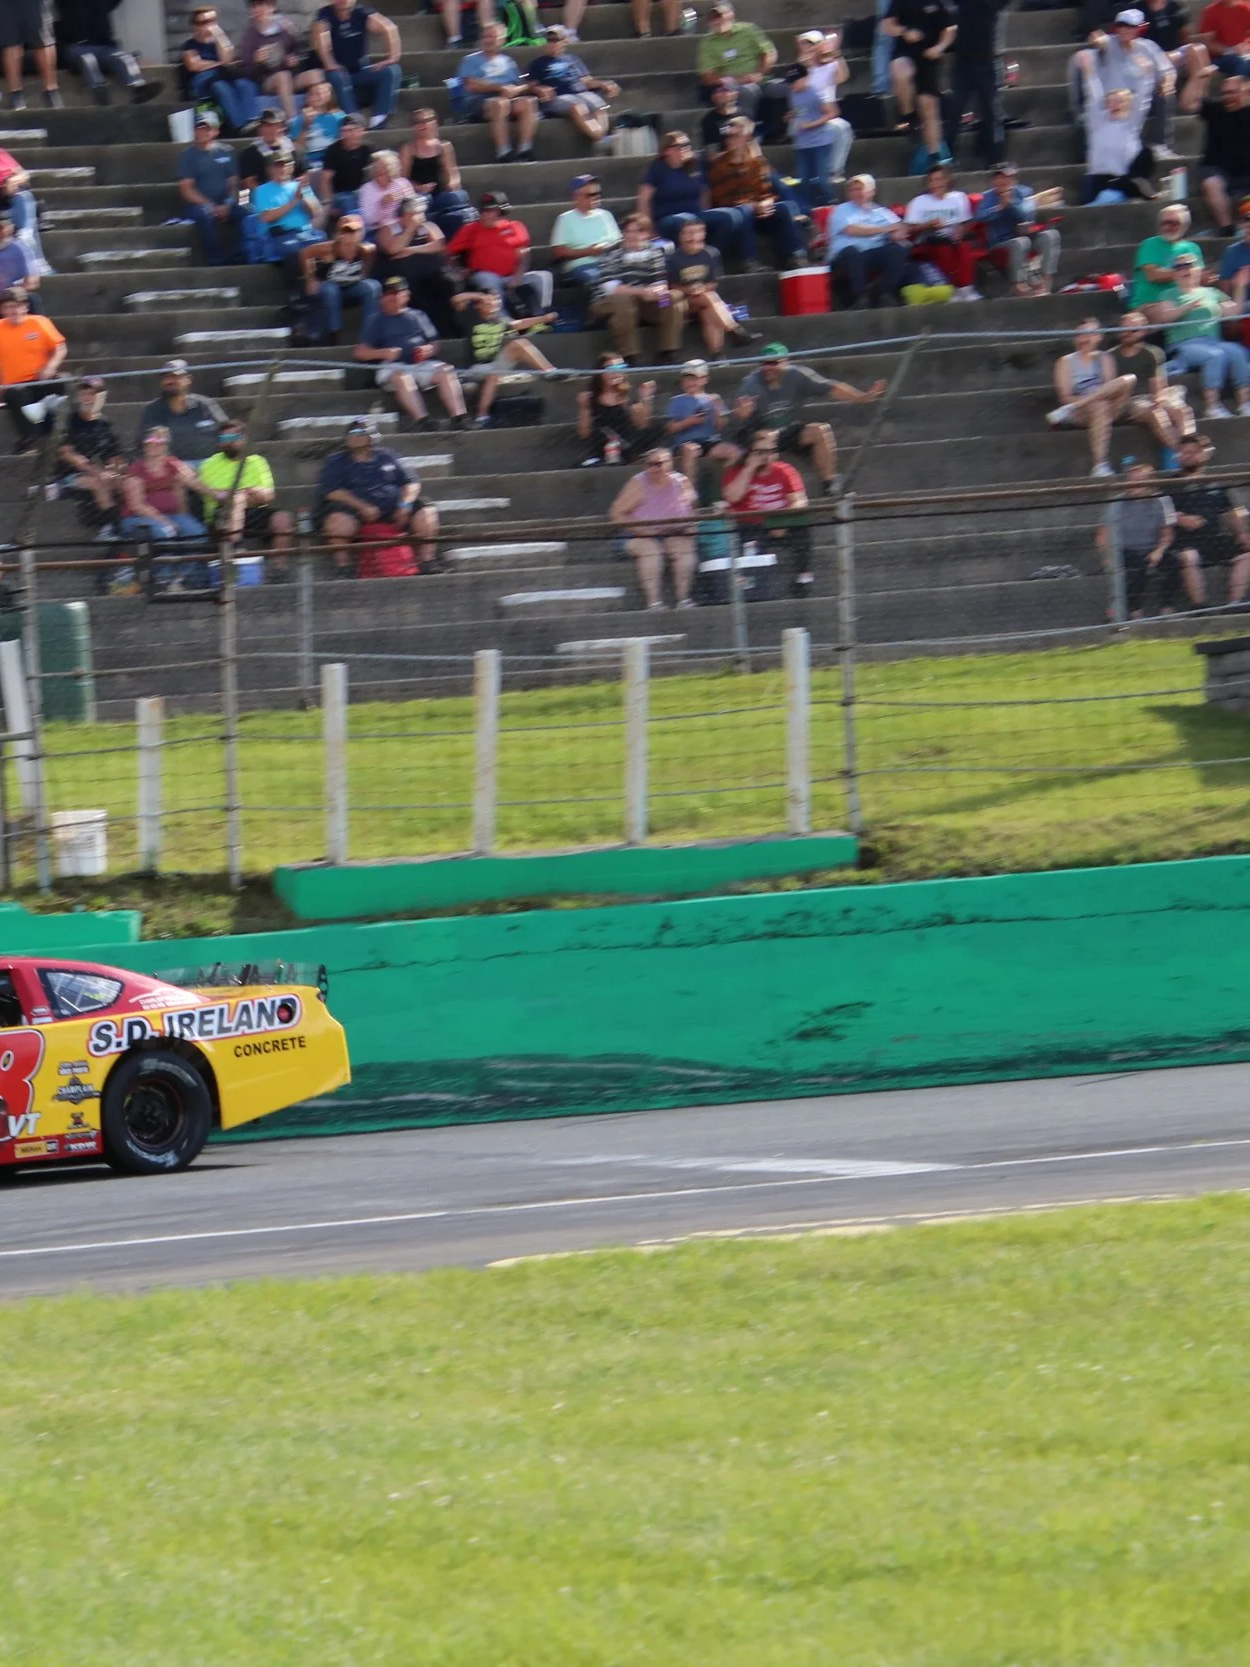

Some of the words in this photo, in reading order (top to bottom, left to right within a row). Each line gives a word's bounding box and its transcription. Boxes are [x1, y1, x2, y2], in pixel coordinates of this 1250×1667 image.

[91, 1018, 158, 1054] S.D
[164, 996, 299, 1040] IRELAND
[234, 1036, 306, 1058] CONCRETE
[8, 1112, 41, 1137] VT
